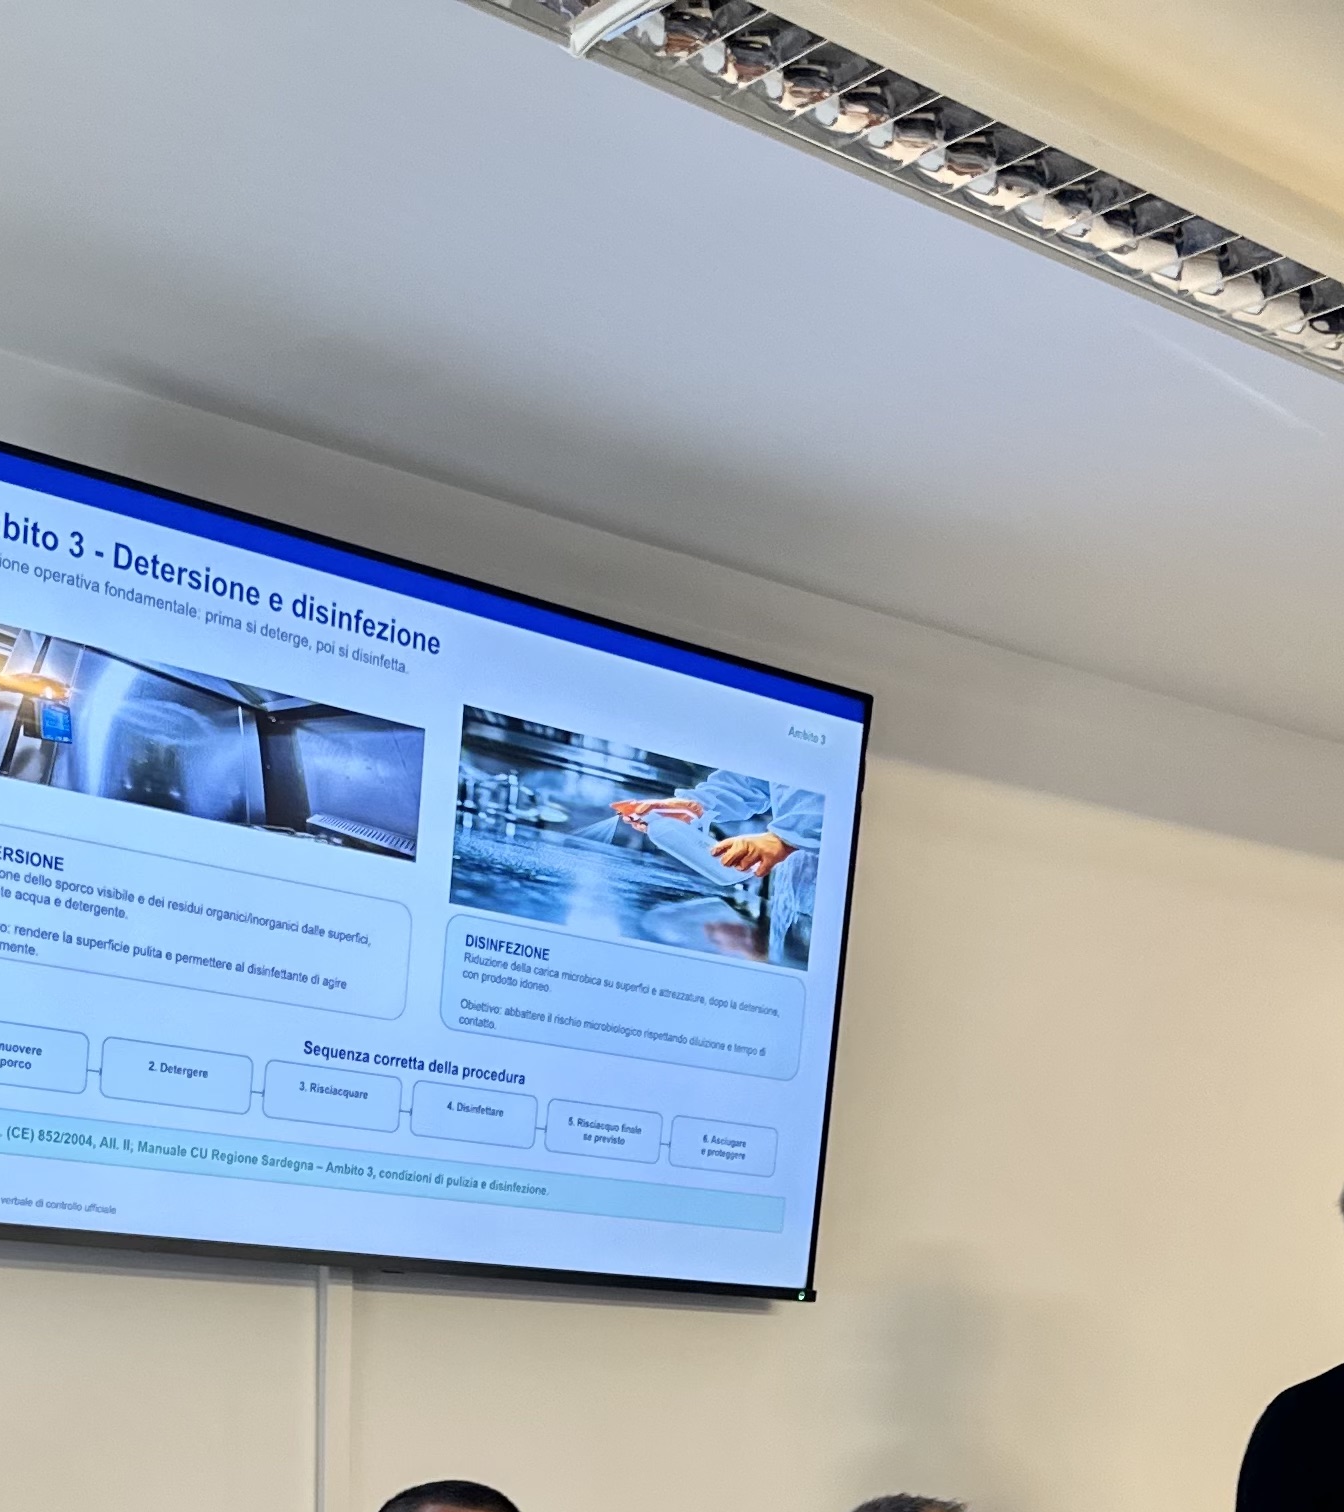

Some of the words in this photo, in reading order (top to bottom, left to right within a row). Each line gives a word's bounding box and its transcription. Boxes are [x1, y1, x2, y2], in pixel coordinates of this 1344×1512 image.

[69, 531, 84, 558] 3
[113, 542, 260, 606] Detersione
[269, 592, 283, 612] e
[292, 594, 440, 655] disinfezione
[33, 566, 100, 594] operativa
[205, 611, 242, 630] prima
[245, 620, 257, 635] si
[260, 624, 312, 651] deterge,
[316, 640, 335, 655] poi
[338, 645, 349, 658] si
[351, 648, 407, 674] disinfetta.
[788, 726, 819, 743] Ambito
[820, 734, 826, 745] 3
[15, 891, 51, 906] acqua
[54, 897, 62, 907] e
[64, 897, 128, 919] detergente.
[23, 872, 52, 888] dello
[55, 880, 94, 895] sporco
[97, 886, 135, 903] visibile
[137, 895, 145, 905] e
[147, 895, 165, 908] dei
[167, 900, 203, 915] residui
[205, 908, 299, 932] organici/inorganici
[301, 924, 325, 937] dalle
[327, 930, 371, 947] superfici,
[14, 925, 60, 942] rendere
[62, 931, 73, 944] la
[76, 936, 130, 954] superficie
[132, 946, 162, 959] pulita
[165, 951, 172, 961] e
[175, 953, 232, 971] permettere
[235, 962, 245, 973] al
[247, 964, 308, 983] disinfettante
[310, 974, 320, 985] di
[322, 977, 347, 990] agire
[465, 934, 550, 961] DISINFEZIONE
[462, 970, 479, 980] con
[480, 972, 518, 987] prodotto
[463, 952, 509, 970] Riduzione
[510, 961, 531, 974] della
[533, 967, 559, 979] carica
[561, 971, 602, 986] microbica
[603, 979, 614, 988] su
[615, 981, 650, 994] superfici
[651, 987, 657, 996] e
[708, 997, 728, 1008] dopo
[729, 1000, 737, 1010] la
[504, 1007, 545, 1022] abbattere
[547, 1013, 552, 1023] il
[553, 1014, 582, 1028] rischio
[583, 1020, 642, 1038] microbiologico
[643, 1029, 688, 1044] rispettando
[689, 1036, 725, 1051] diluizione
[733, 1043, 757, 1057] tempo
[759, 1047, 766, 1057] di
[148, 1061, 156, 1071] 2.
[160, 1062, 208, 1079] Detergere
[303, 1040, 370, 1063] Sequenza
[373, 1054, 424, 1071] corretta
[428, 1059, 459, 1076] della
[462, 1067, 525, 1085] procedura
[299, 1081, 307, 1092] 3.
[309, 1082, 368, 1100] Risciacquare
[446, 1101, 454, 1111] 4.
[456, 1102, 504, 1117] Disinfettare
[577, 1118, 620, 1132] Risciacquo
[621, 1123, 642, 1134] finale
[583, 1133, 592, 1141] se
[593, 1135, 625, 1145] previsto
[710, 1135, 746, 1148] Asciugare
[6, 1126, 35, 1144] (CE)
[37, 1129, 96, 1149] 852/2004,
[99, 1137, 119, 1150] All.
[123, 1139, 133, 1153] II;
[137, 1140, 187, 1157] Manuale
[190, 1147, 208, 1160] CU
[211, 1149, 258, 1165] Regione
[261, 1154, 314, 1172] Sardegna
[325, 1161, 365, 1177] Ambito
[366, 1166, 376, 1180] 3,
[378, 1169, 432, 1183] condizioni
[434, 1174, 444, 1185] di
[446, 1176, 478, 1189] pulizia
[480, 1181, 487, 1189] e
[489, 1179, 548, 1195] disinfezione.
[706, 1149, 746, 1161] proteggere
[0, 1197, 33, 1207] verbale
[35, 1198, 44, 1208] di
[45, 1201, 82, 1211] controllo
[84, 1203, 116, 1214] ufficiale
